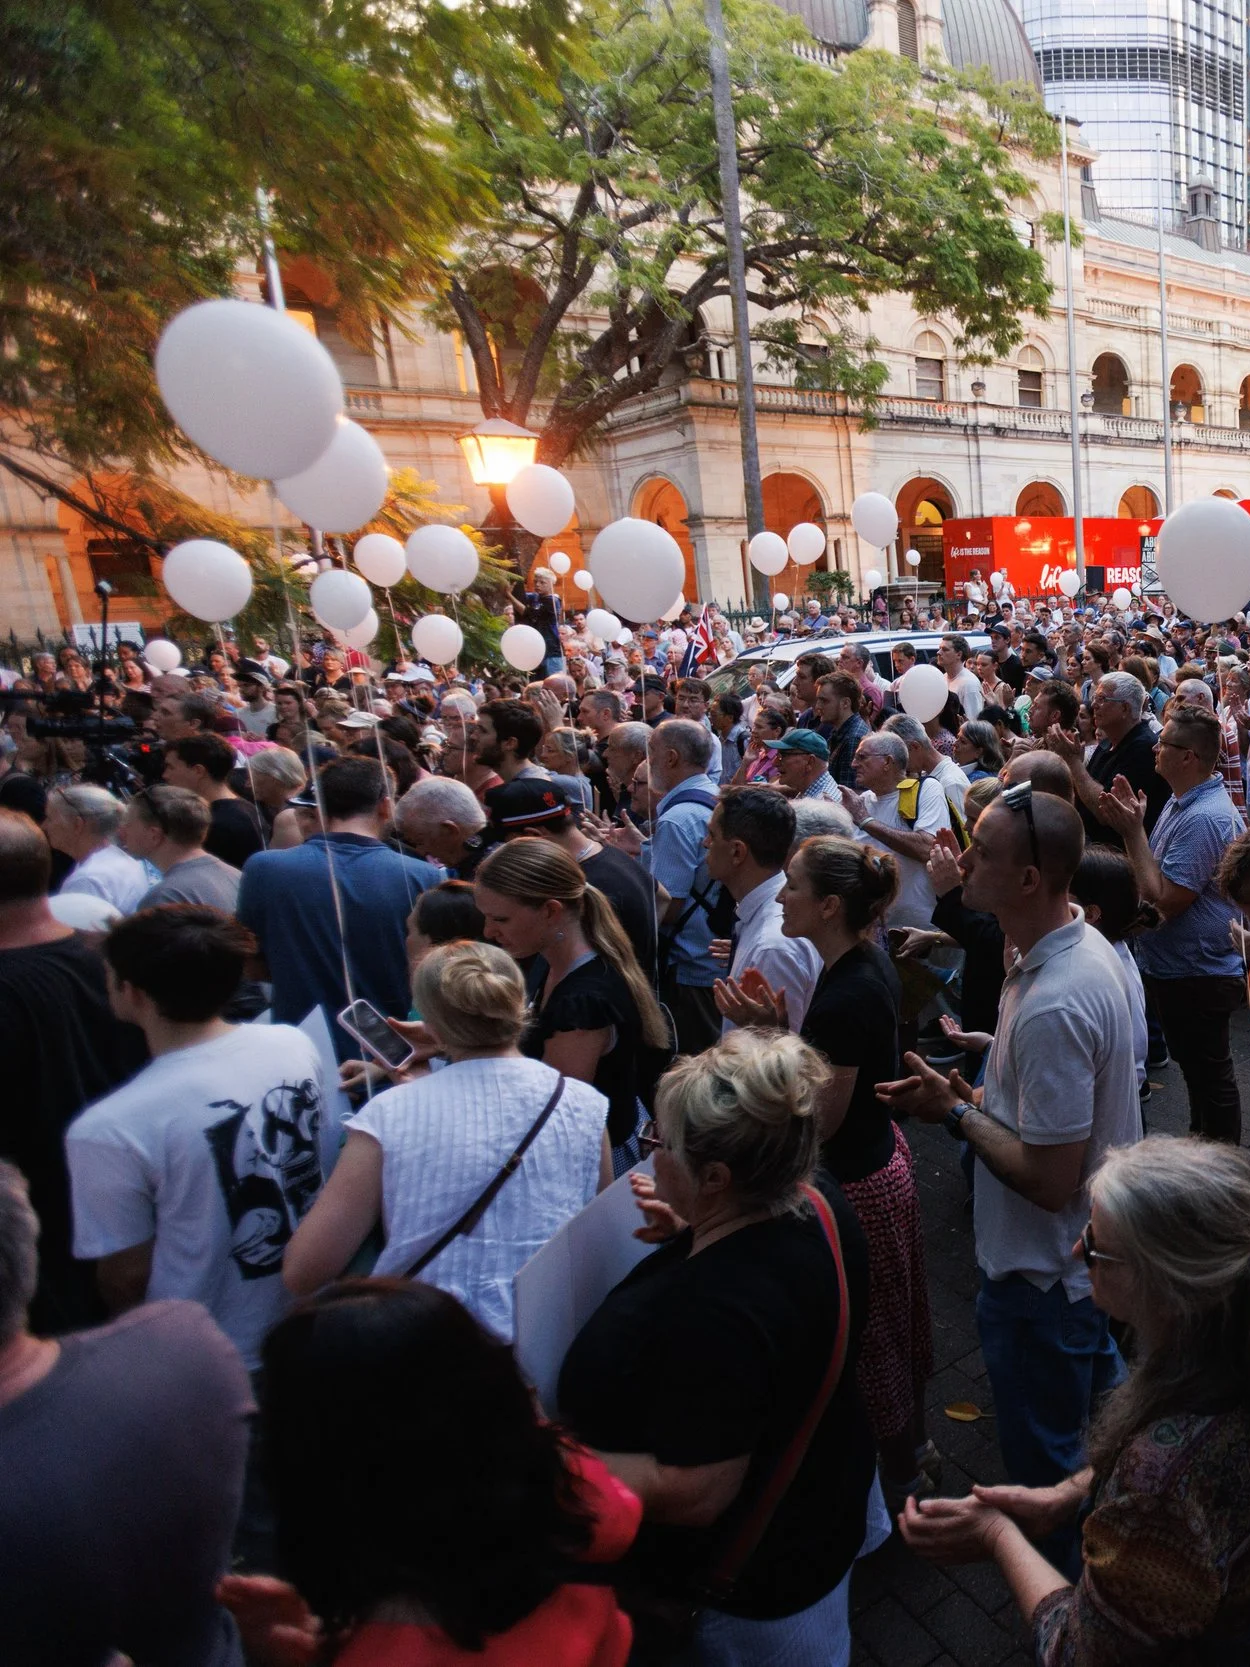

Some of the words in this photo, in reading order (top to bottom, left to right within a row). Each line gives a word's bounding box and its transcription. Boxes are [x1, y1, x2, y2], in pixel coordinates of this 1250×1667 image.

[973, 546, 990, 556] REASON
[1040, 564, 1061, 590] lif
[1107, 567, 1141, 583] REASO
